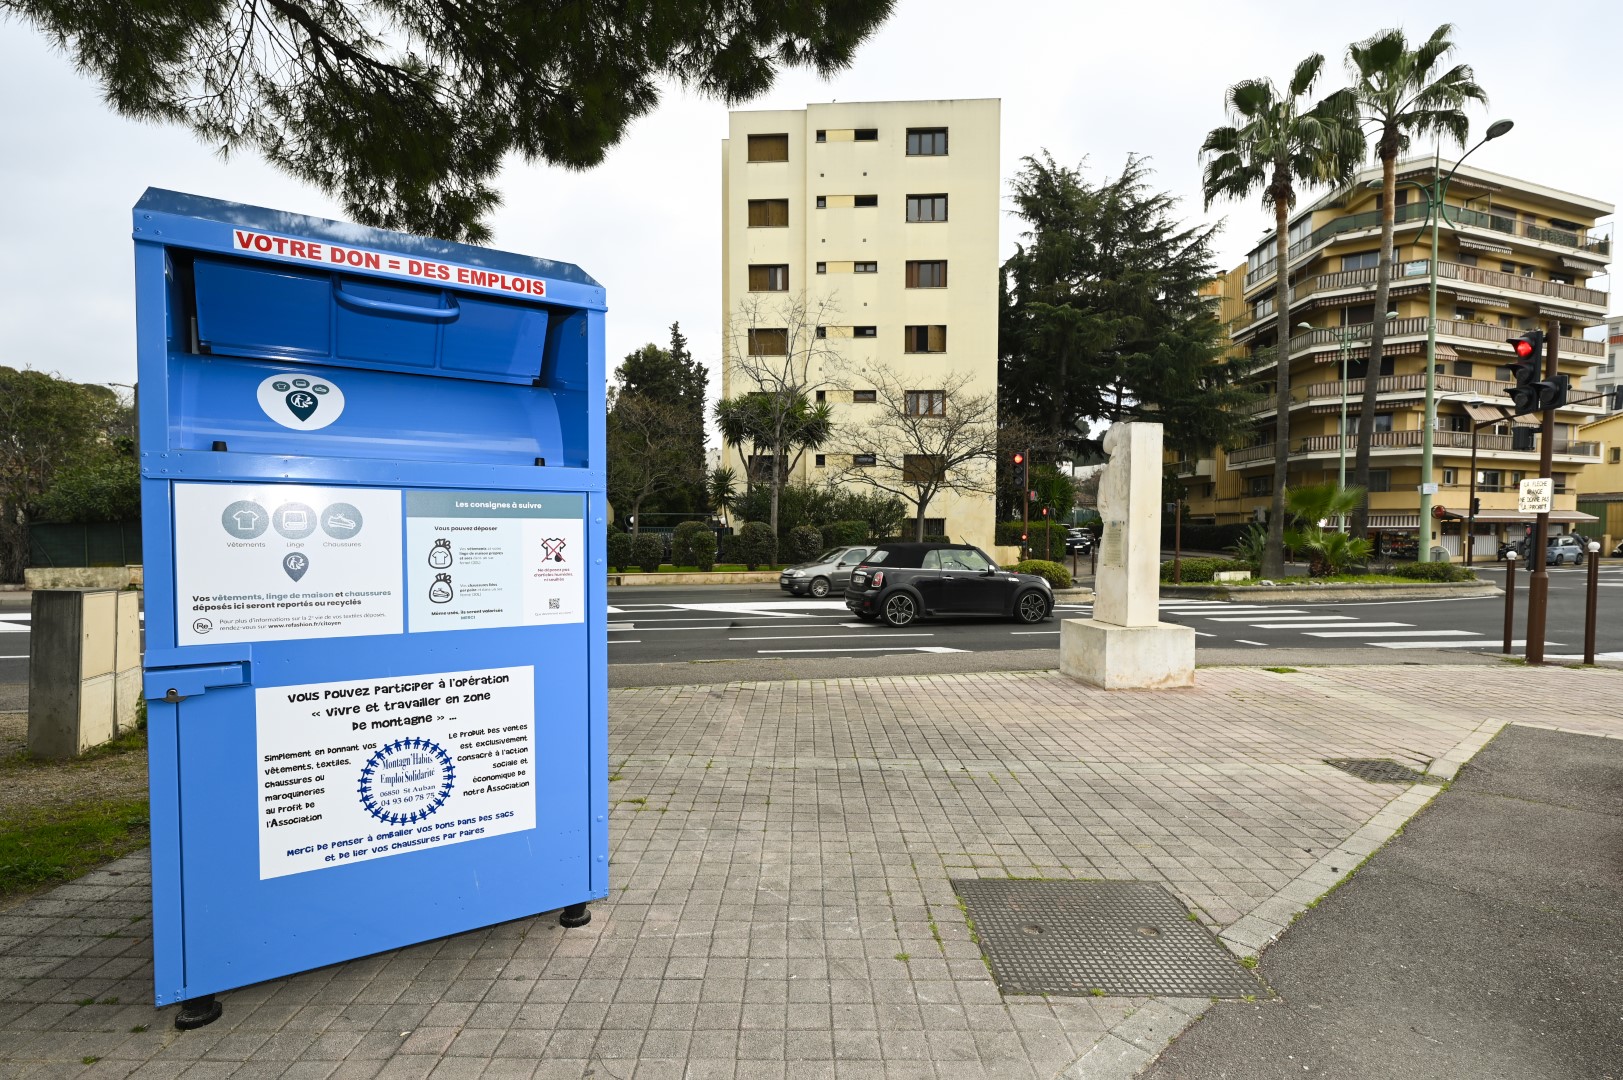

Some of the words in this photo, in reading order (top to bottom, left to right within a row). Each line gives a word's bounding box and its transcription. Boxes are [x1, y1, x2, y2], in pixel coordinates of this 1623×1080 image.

[236, 231, 322, 260] VOTRE
[331, 248, 380, 269] DON
[389, 260, 400, 269] =
[409, 260, 450, 280] DES
[458, 268, 544, 295] EMPLOIS
[192, 603, 232, 612] déposés
[277, 600, 313, 609] reportés
[327, 599, 362, 607] recyclés
[439, 679, 445, 688] à
[366, 703, 380, 712] et
[384, 697, 441, 710] travailler
[446, 695, 459, 704] en
[463, 692, 491, 702] zone
[372, 714, 432, 729] montagne
[476, 735, 528, 747] exclusivement
[457, 751, 492, 761] consacré
[502, 747, 528, 755] l'action
[493, 759, 517, 768] sociale
[380, 772, 403, 787] Emploi
[405, 768, 435, 782] Solidarité
[473, 772, 515, 783] économique
[265, 788, 325, 802] maroquineries
[463, 788, 484, 796] notre
[487, 781, 529, 793] Association
[266, 814, 322, 828] l'Association
[287, 846, 314, 857] Merci
[417, 825, 432, 834] vos
[495, 811, 514, 819] sacs
[353, 849, 368, 857] lier
[372, 845, 388, 853] vos
